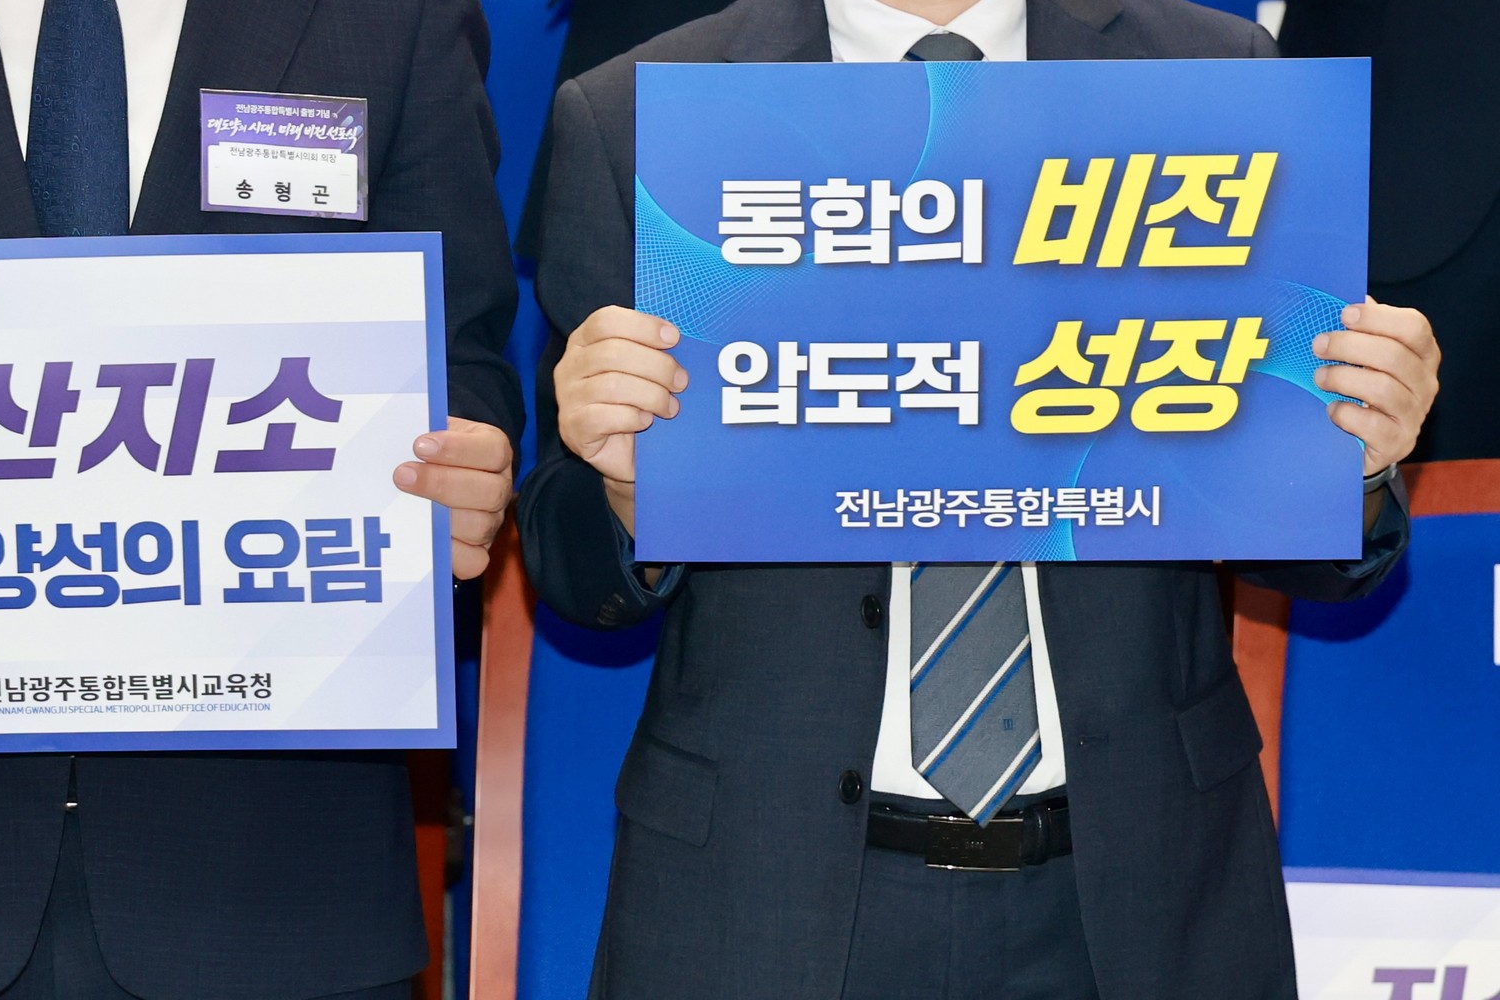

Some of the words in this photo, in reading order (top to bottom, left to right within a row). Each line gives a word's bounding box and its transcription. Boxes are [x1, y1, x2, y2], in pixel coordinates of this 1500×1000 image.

[235, 103, 300, 118] 전남광주통합특별시
[300, 107, 315, 118] 출범
[315, 108, 331, 119] 기념
[207, 117, 248, 137] 대도약의
[278, 122, 304, 141] 미래
[303, 123, 328, 140] 비전
[326, 125, 358, 151] 선포식
[229, 146, 319, 162] 전남광주통합특별시의회
[320, 152, 337, 164] 의장
[717, 177, 984, 266] 통합의
[1012, 151, 1279, 269] 비전
[716, 339, 981, 427] 압도적
[1009, 315, 1270, 436] 성장
[834, 484, 1162, 529] 전남광주통합특별시
[223, 516, 391, 604] 요람
[25, 705, 67, 715] GWANGJU
[68, 704, 104, 714] SPECIAL
[105, 703, 175, 714] METROPOLITAN
[175, 703, 205, 713] OFFICE
[207, 703, 219, 712] OF
[220, 702, 271, 712] EDUCATION
